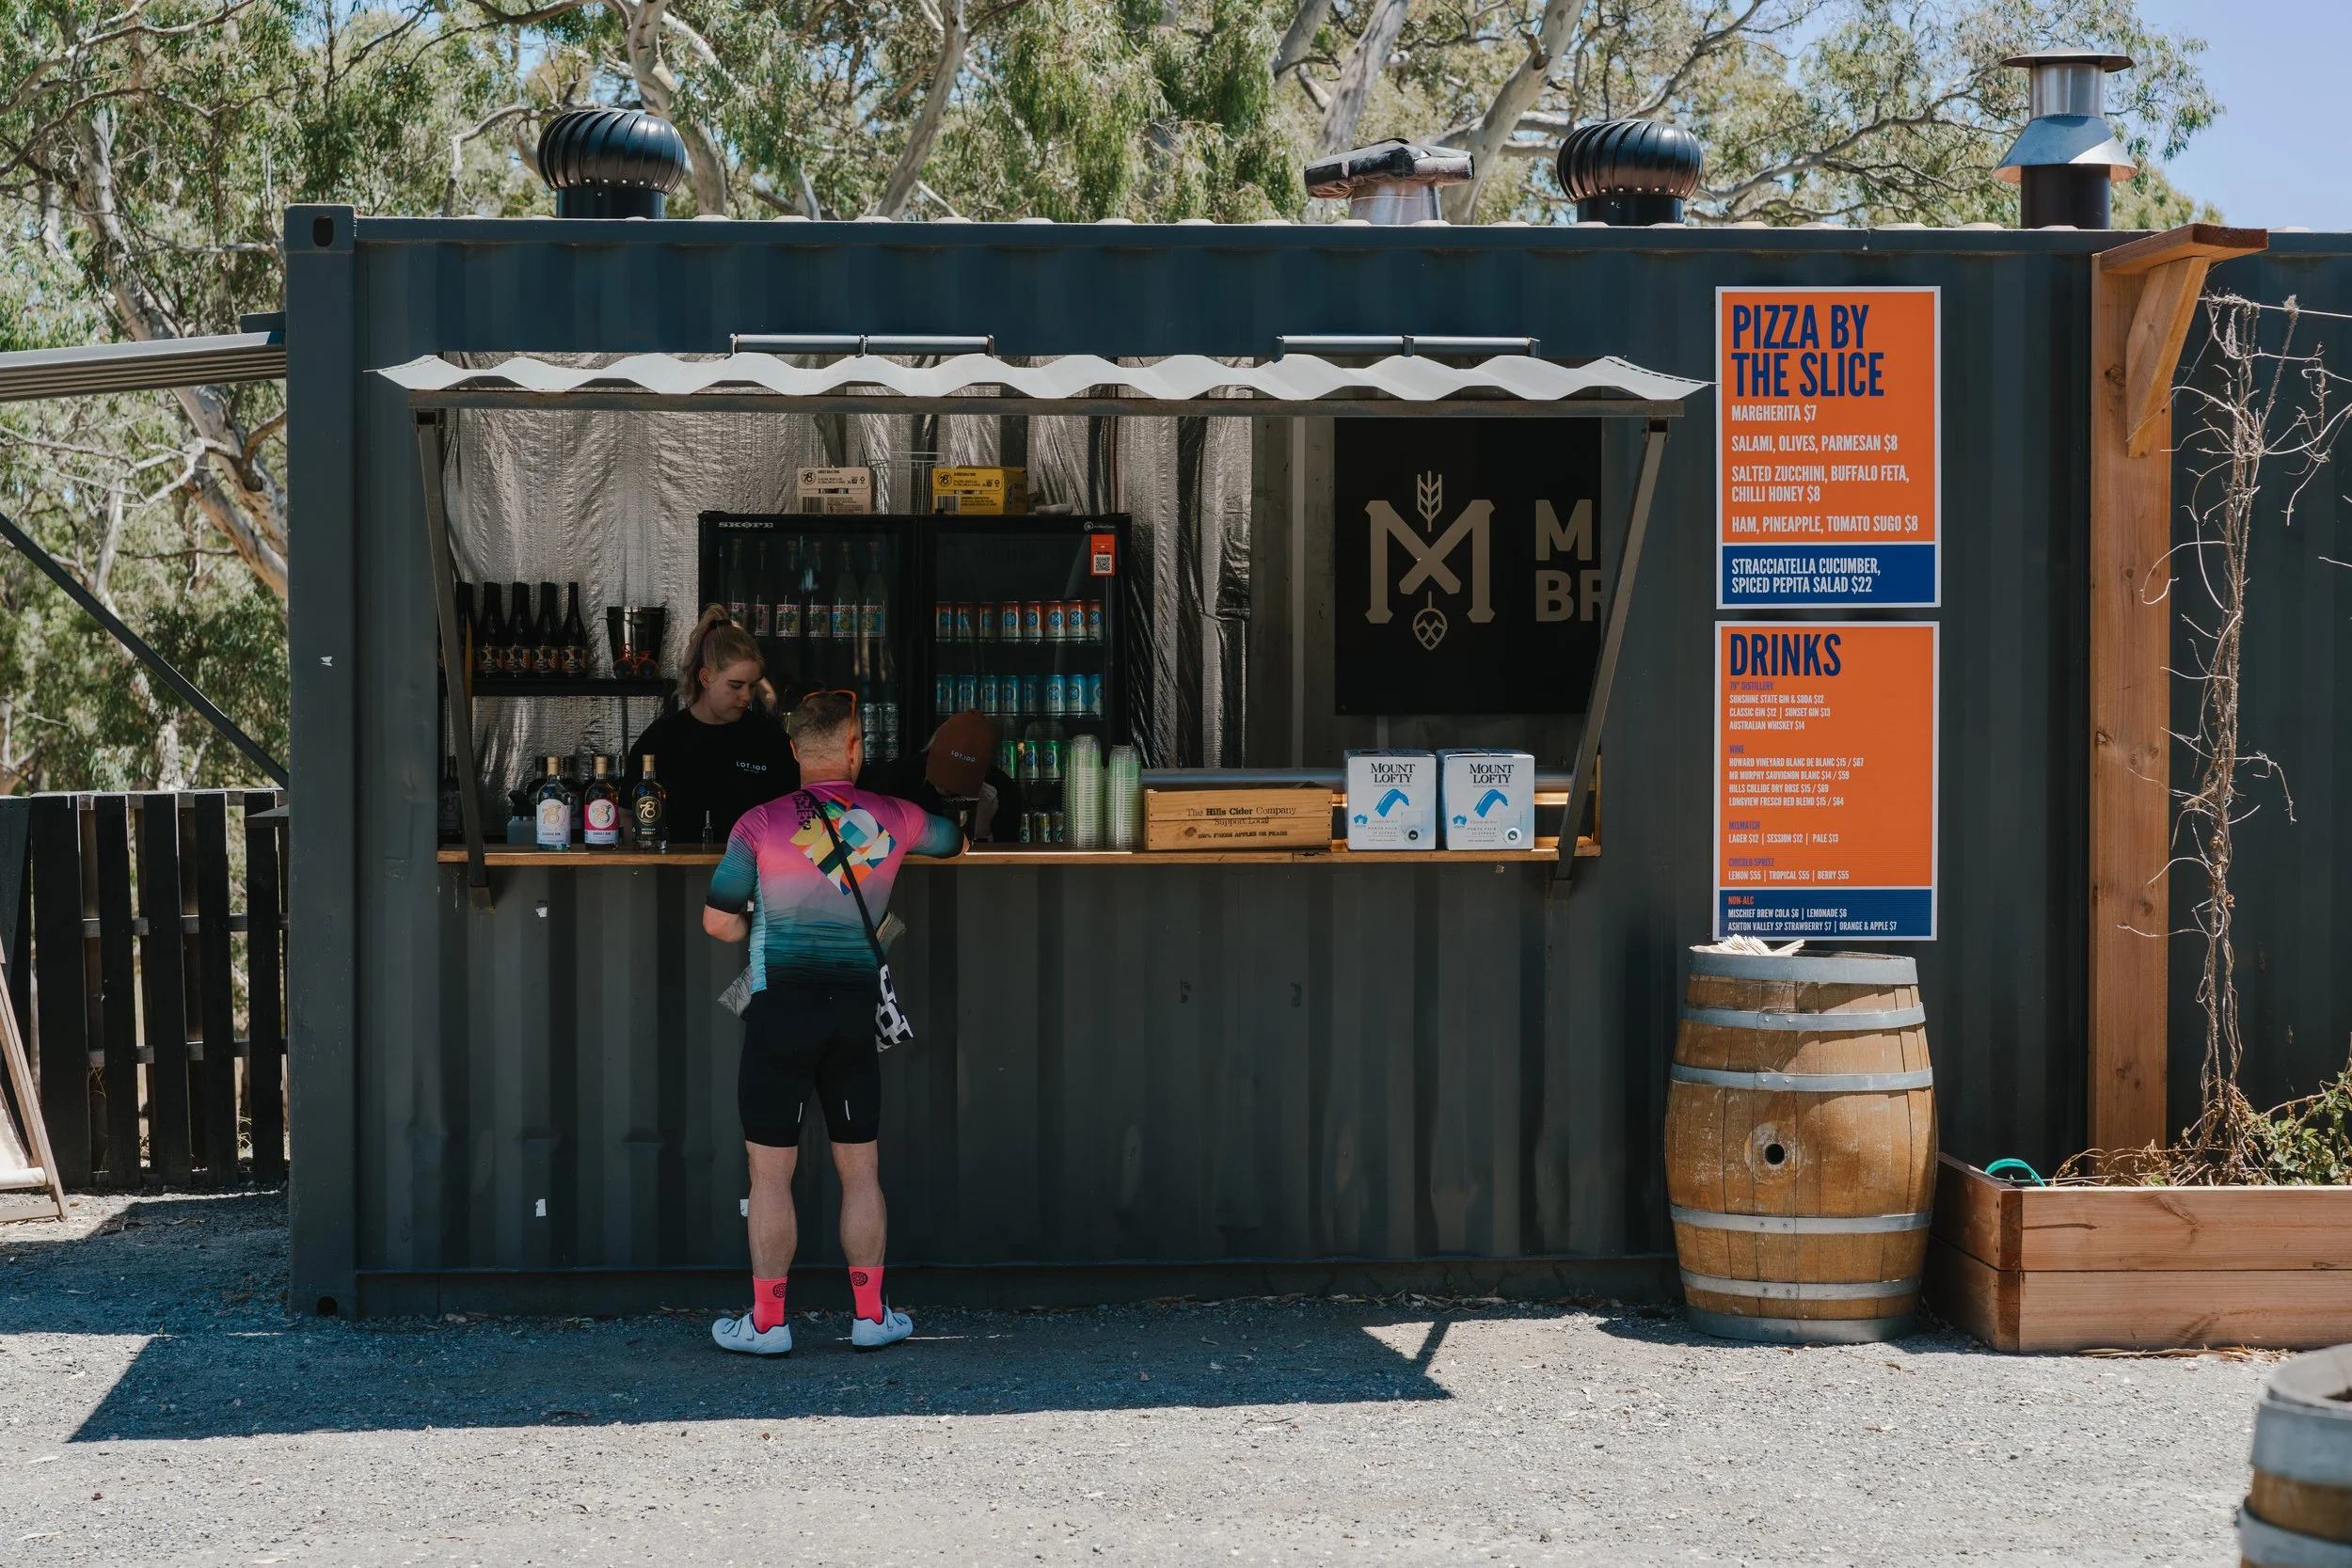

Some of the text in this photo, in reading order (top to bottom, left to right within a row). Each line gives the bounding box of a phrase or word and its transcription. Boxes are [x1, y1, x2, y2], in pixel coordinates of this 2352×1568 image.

[1733, 305, 1869, 349] PIZZA BY
[1731, 352, 1883, 397] THE SLICE
[1731, 404, 1817, 422] MARGHERITA $7
[1732, 434, 1897, 453] SALAMI, OLIVES, PARMESAN $8
[1732, 466, 1909, 483] SALTED ZUCCHINI, BUFFALO FETA,
[1732, 484, 1820, 503] CHILLI HONEY $8
[1732, 515, 1917, 534] HAM, PINEAPPLE, TOMATO SUGO $8
[1732, 558, 1881, 576] STRACCIATELLA CUCUMBER,
[1732, 576, 1872, 594] SPICED PEPITA SALAD $22
[1730, 634, 1841, 676] DRINKS
[1730, 694, 1824, 704] SUNSHINE STATE GIN & SODA $12
[1729, 707, 1830, 717] CLASSIC GIN $12 SUNSET GIN $13
[1729, 721, 1804, 730] AUSTRALIAN WHISKEY $14
[1729, 757, 1754, 768] HOWARD
[1756, 757, 1785, 768] VINEYARD
[1786, 757, 1805, 768] BLANC
[1806, 757, 1814, 768] DE
[1816, 757, 1835, 768] BLANC
[1836, 757, 1846, 768] $15
[1371, 763, 1415, 773] MOUNT
[1470, 763, 1514, 774] MOUNT
[1375, 774, 1412, 783] LOFTY
[1473, 774, 1511, 784] LOFTY
[1729, 770, 1739, 780] MR
[1740, 770, 1763, 780] MURPHY
[1766, 770, 1799, 780] SAUVIGNON
[1801, 770, 1820, 780] BLANC
[1821, 770, 1832, 780] $14
[1729, 784, 1745, 793] HILLS
[1747, 784, 1770, 793] COLLIDE
[1772, 784, 1783, 793] DRY
[1785, 784, 1799, 793] ROSE
[1801, 784, 1810, 793] $15
[1729, 798, 1758, 806] LONGVIEW
[1760, 798, 1782, 806] FRESCO
[1784, 798, 1794, 806] RED
[1796, 798, 1814, 806] BLEND
[1816, 798, 1826, 806] $15
[1256, 807, 1296, 816] Company
[1729, 834, 1838, 844] LAGER $12 SESSION $12 PALE $13
[1728, 871, 1849, 880] LEMON $55 TROPICAL $55 BERRY $55
[1728, 909, 1847, 918] MISCHIEF BREW COLA $6 LEMONADE $6
[1728, 922, 1897, 931] ASHTON VALLEY SP STRAWBERRY $7 ORANGE & APPLE $7
